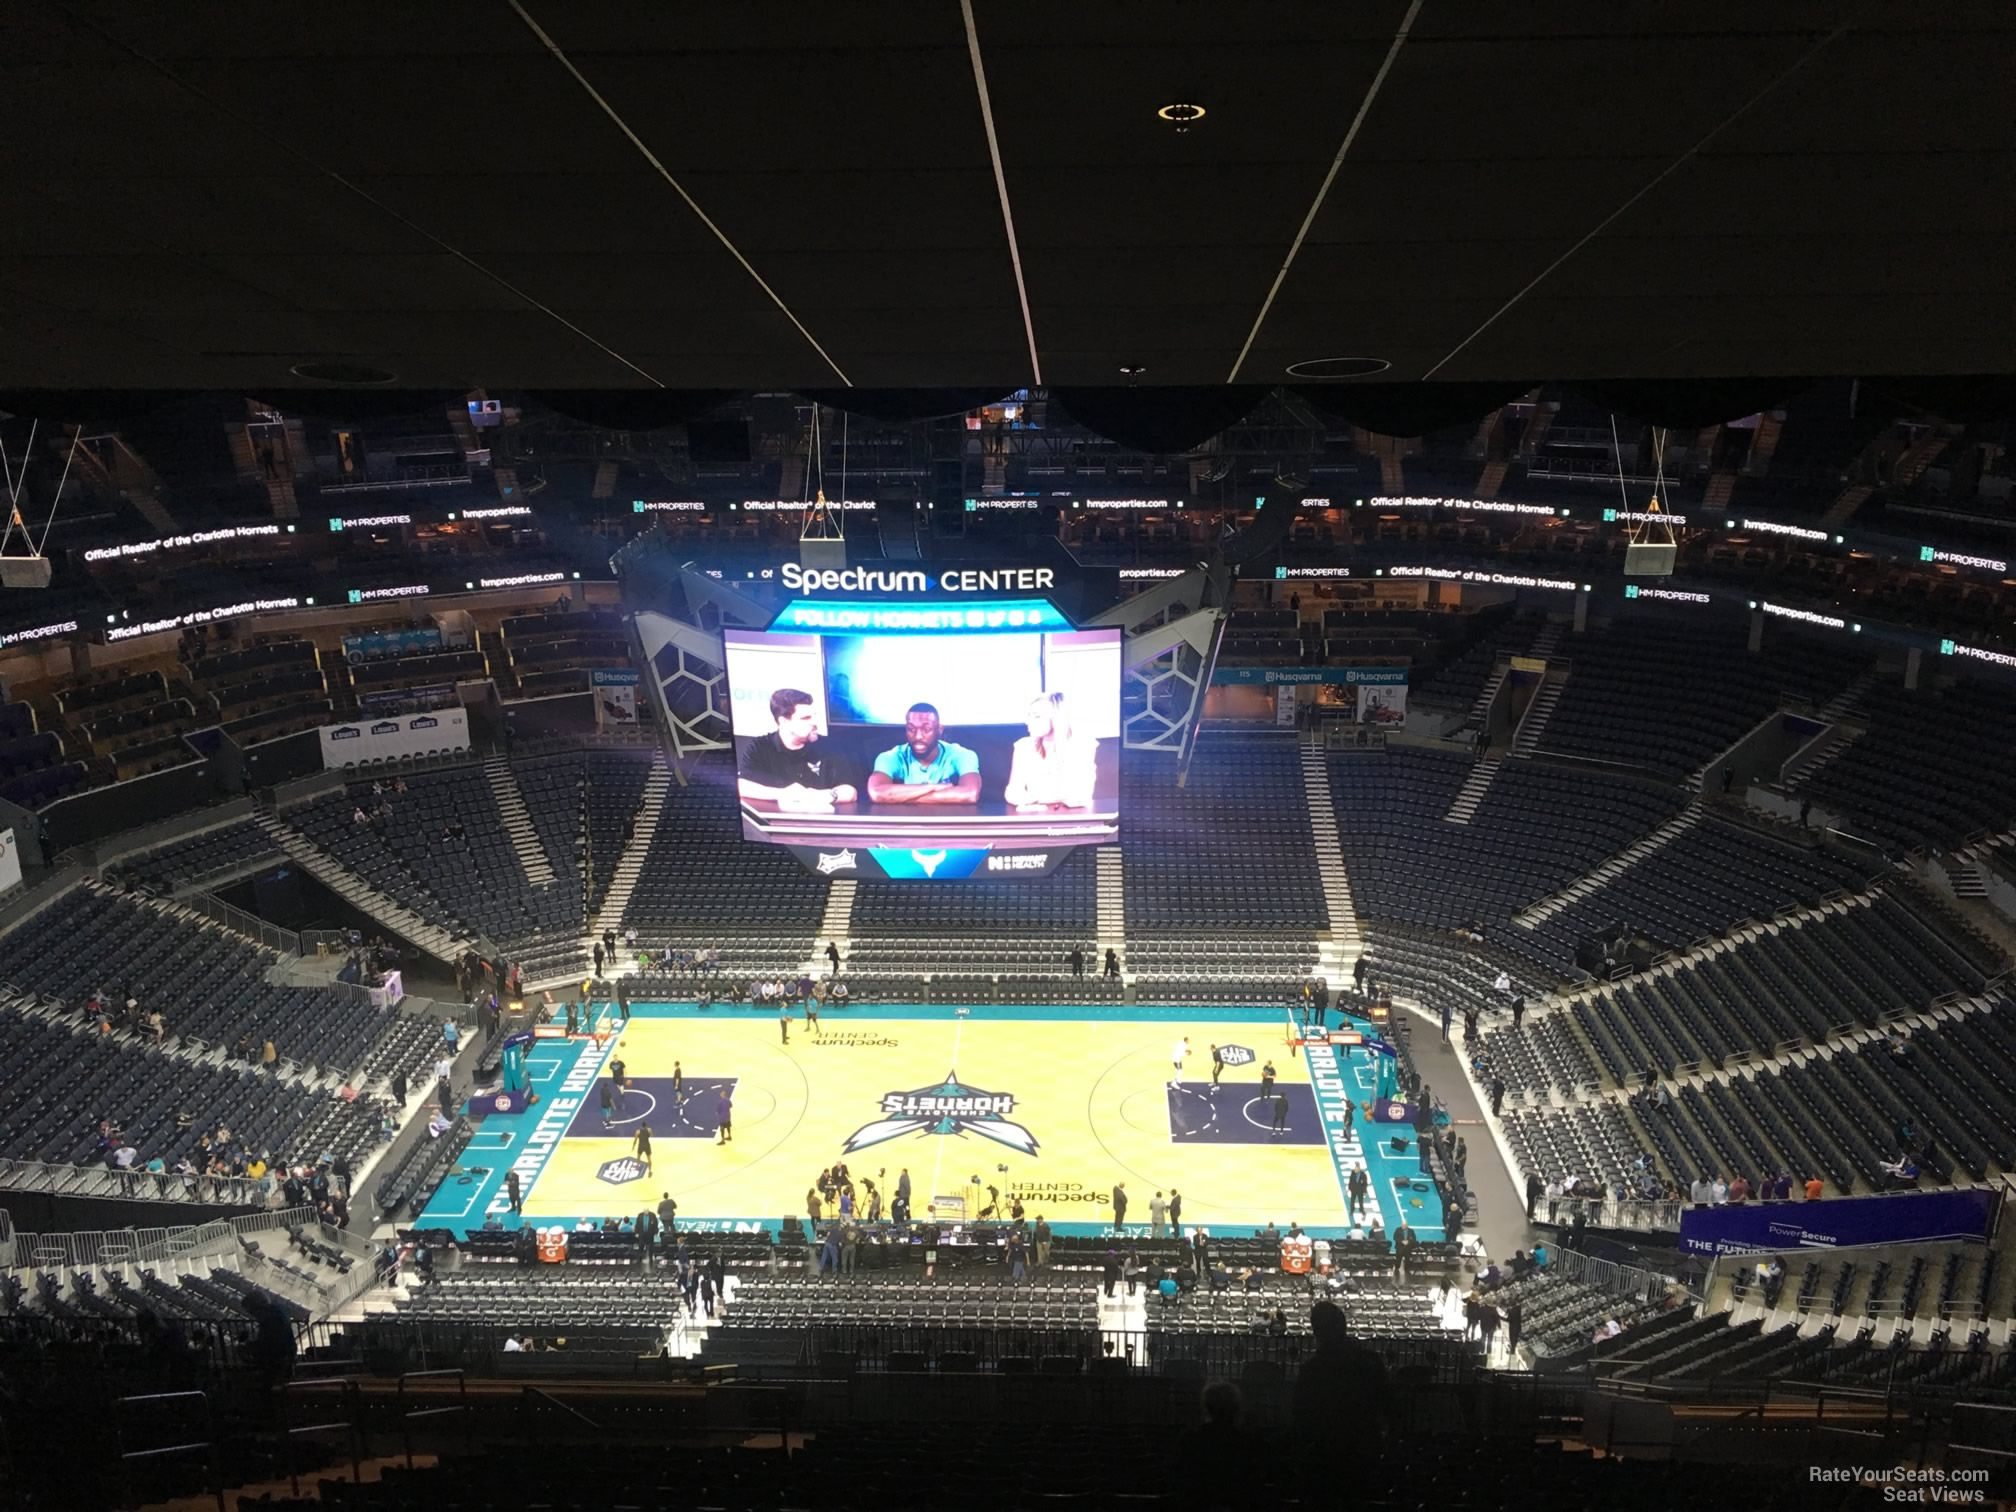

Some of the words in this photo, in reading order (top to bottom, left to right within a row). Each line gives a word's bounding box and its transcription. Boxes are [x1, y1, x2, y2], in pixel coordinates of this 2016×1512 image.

[658, 502, 705, 511] PROPERTIES
[743, 501, 776, 511] Official
[826, 501, 841, 510] the
[976, 500, 990, 509] HM
[991, 500, 1038, 509] PROPERTES
[1086, 499, 1168, 509] hmproperties.com
[1370, 497, 1403, 506] Official
[1444, 499, 1455, 507] of
[1456, 500, 1471, 508] the
[1472, 501, 1516, 511] Charlotte
[1517, 503, 1555, 514] Hornets
[342, 519, 357, 528] HM
[358, 514, 411, 527] PROPERTIES
[1616, 511, 1631, 520] HM
[1632, 512, 1686, 524] PROPERTIES
[1744, 519, 1828, 541] hmproperties.com
[85, 546, 121, 561] Official
[163, 538, 174, 549] of
[175, 535, 191, 546] the
[192, 527, 236, 543] Charlotte
[237, 525, 279, 537] Hornets
[1934, 551, 1949, 562] HM
[1950, 554, 2007, 572] PROPERTIES
[781, 563, 926, 596] Spectrum
[940, 568, 1054, 592] CENTER
[1287, 568, 1301, 576] HM
[1302, 568, 1350, 577] PROPERTIES
[1390, 567, 1423, 576] Official
[1463, 571, 1475, 580] of
[1475, 572, 1490, 582] the
[1492, 573, 1536, 586] Charlotte
[1537, 577, 1576, 590] Hornets
[480, 572, 564, 588] hmproperties.com
[361, 590, 376, 599] HM
[376, 585, 429, 598] PROPERTIES
[1638, 588, 1654, 597] HM
[1655, 590, 1710, 603] PROPERTIES
[183, 613, 195, 625] of
[195, 611, 211, 622] the
[212, 602, 255, 619] Charlotte
[256, 597, 298, 610] Hornets
[1763, 602, 1845, 628] hmproperties.com
[794, 610, 868, 627] FOLLOW
[2, 633, 19, 645] HM
[20, 621, 78, 641] PROPERTIES
[1954, 645, 1970, 657] HM
[1275, 671, 1322, 682] Husqvarna
[1355, 671, 1404, 682] Husqvarna
[815, 1038, 899, 1047] Spectrum
[1302, 1024, 1348, 1122] CARLOTTE
[883, 1095, 1014, 1113] HORNETS
[1012, 1182, 1083, 1191] CENTER
[1010, 1191, 1110, 1205] Spectrum
[1687, 1238, 1713, 1252] THE
[545, 1248, 557, 1257] G
[1291, 1258, 1302, 1268] G
